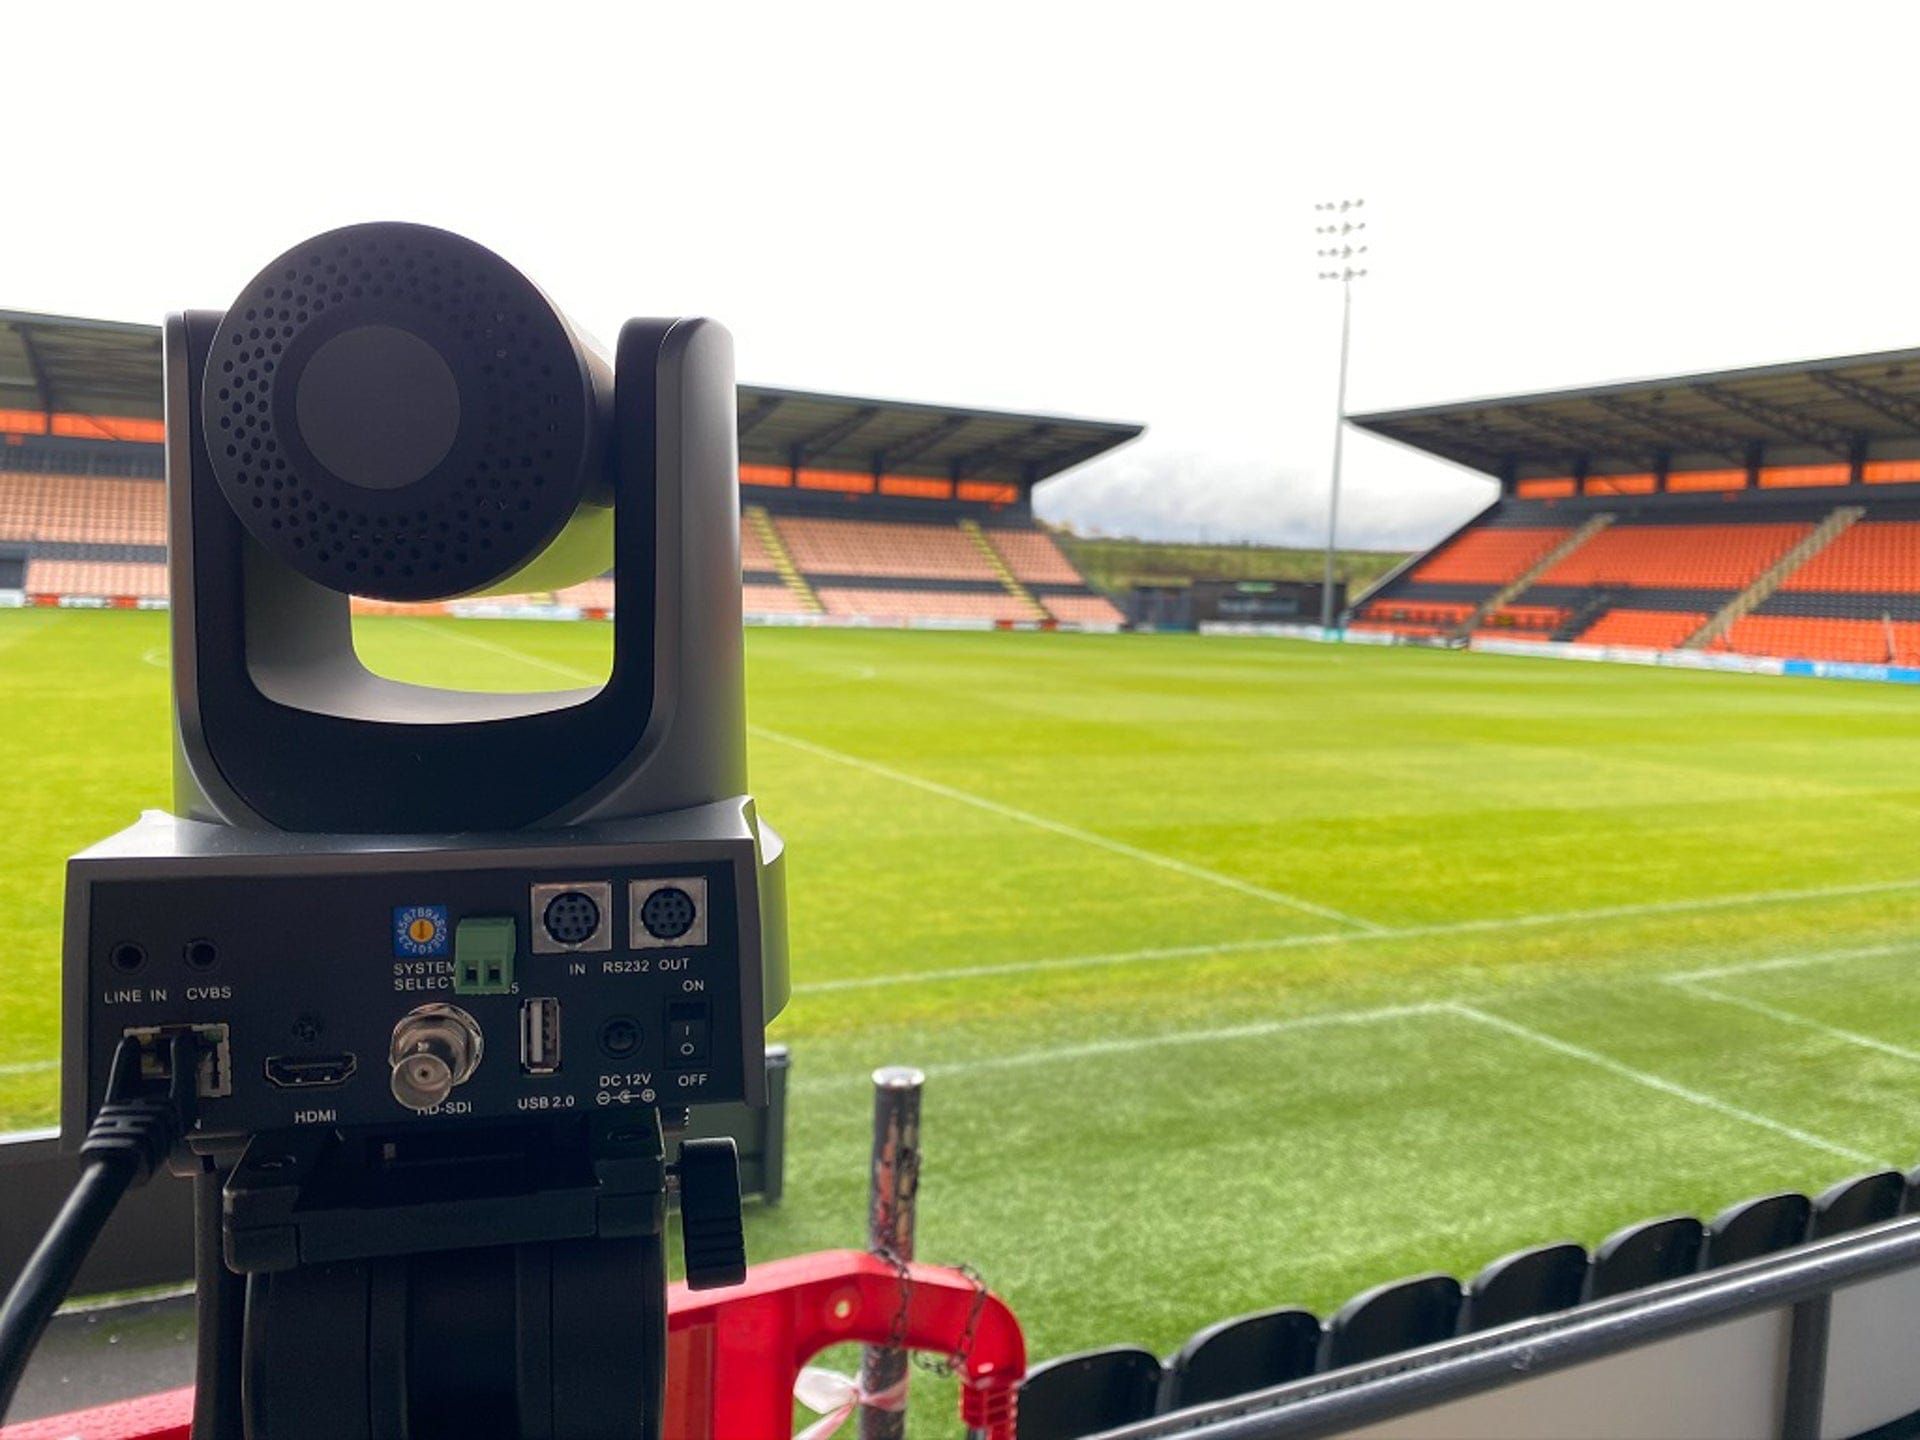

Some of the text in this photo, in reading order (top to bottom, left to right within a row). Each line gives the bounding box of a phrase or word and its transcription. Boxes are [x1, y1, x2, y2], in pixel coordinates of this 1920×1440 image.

[393, 961, 456, 976] SYSTEM
[569, 957, 690, 976] IN RS232 OUT
[394, 976, 456, 991] SELECT
[682, 979, 705, 992] ON
[104, 989, 168, 1004] LINE IN
[186, 986, 233, 1000] CVBS
[599, 1073, 652, 1088] DC 12V
[677, 1073, 708, 1087] OFF
[517, 1095, 576, 1110] USB 2.0
[294, 1109, 337, 1124] HDMI
